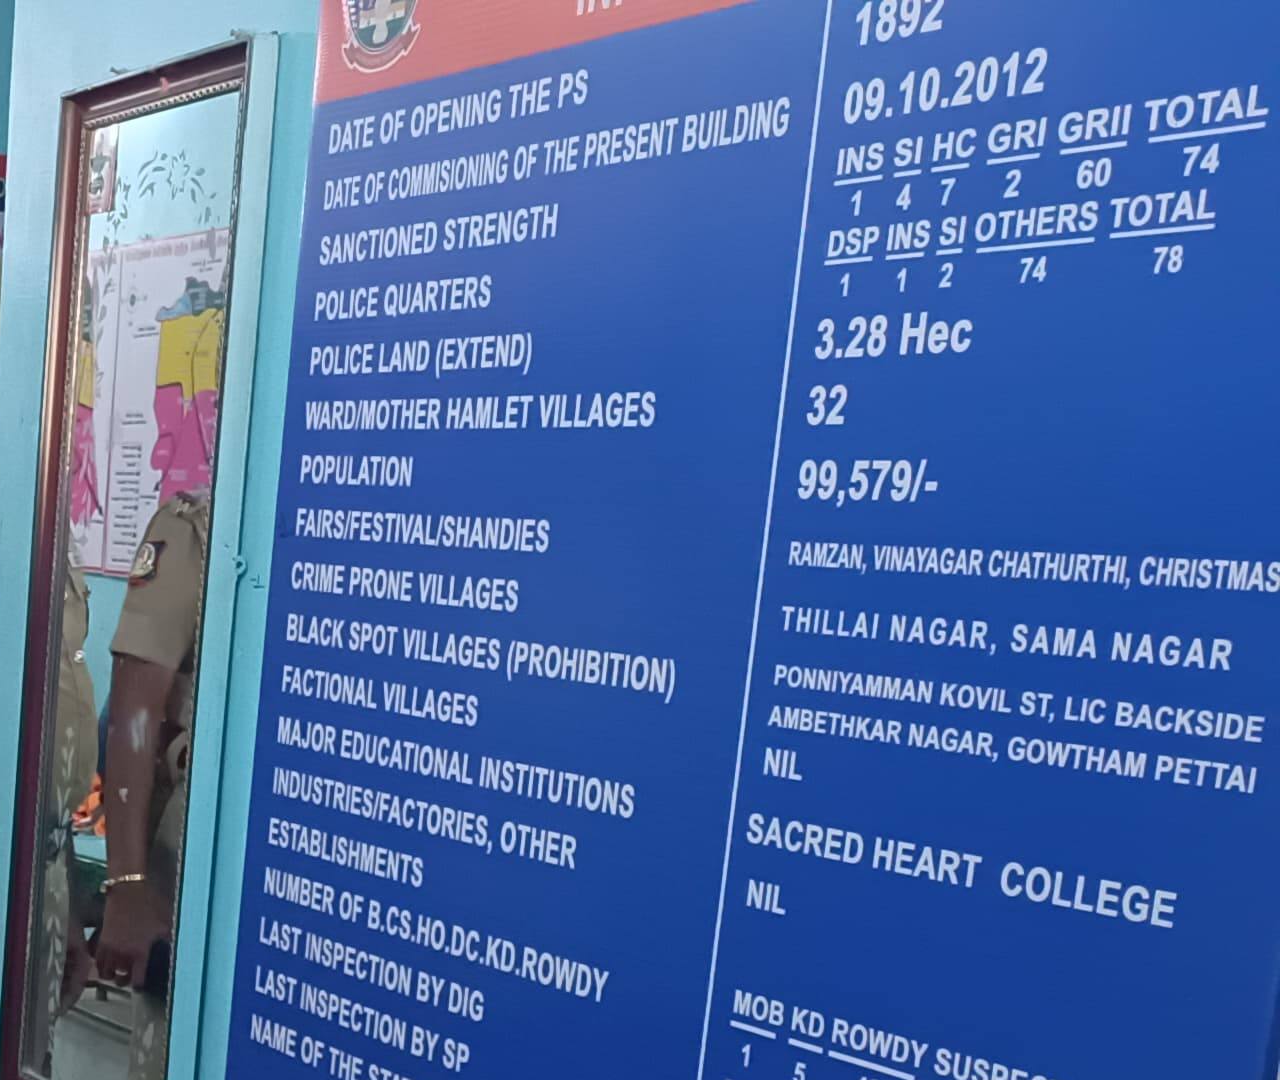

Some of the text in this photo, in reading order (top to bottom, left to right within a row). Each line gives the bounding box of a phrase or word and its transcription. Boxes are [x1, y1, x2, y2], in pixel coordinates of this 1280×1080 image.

[856, 0, 944, 46] 1892
[328, 69, 588, 154] DATE OF OPENING THE PS
[844, 48, 1047, 124] 09.10.2012
[324, 97, 790, 210] DATE OF COMMISIONING OF THE PRESENT BUILDING
[837, 85, 1268, 175] INS SI HC GRI GRII TOTAL
[320, 204, 558, 265] SANCTIONED STRENGTH
[828, 189, 1215, 257] DSP INS SI OTHERS TOTAL
[315, 275, 491, 320] POLICE QUARTERS
[310, 333, 532, 378] POLICE LAND (EXTEND)
[815, 312, 972, 359] 3.28 Hec
[306, 392, 655, 429] WARD/MOTHER HAMLET VILLAGES
[300, 455, 413, 486] POPULATION
[798, 460, 937, 506] 99,579/-
[296, 508, 549, 552] FAIRS/FESTIVAL/SHANDIES
[292, 562, 518, 612] CRIME PRONE VILLAGES
[789, 542, 866, 573] RAMZAN,
[874, 546, 983, 575] VINAYAGAR
[989, 550, 1130, 588] CHATHURTHI,
[287, 614, 674, 703] BLACK SPOT VILLAGES (PROHIBITION)
[782, 606, 1232, 670] THILLAI NAGAR, SAMA NAGAR
[282, 666, 478, 726] FACTIONAL VILLAGES
[774, 665, 1264, 742] PONNIYAMMAN KOVIL ST, LIC BACKSIDE
[278, 717, 634, 818] MAJOR EDUCATIONAL INSTITUTIONS
[764, 748, 801, 780] NIL
[768, 706, 1256, 793] AMBETHKAR NAGAR, GOWTHAM PETTAI
[274, 768, 576, 868] INDUSTRIES/FACTORIES, OTHER
[269, 818, 422, 886] ESTABLISHMENTS
[747, 814, 1176, 928] SACRED HEART COLLEGE
[747, 880, 784, 914] NIL
[264, 868, 608, 1001] NUMBER OF B.CS.HO.DC.KD.ROWDY
[260, 918, 483, 1020] LAST INSPECTION BY DIG
[251, 1015, 296, 1056] NAME
[302, 1037, 324, 1066] OF
[734, 990, 784, 1025] MOB
[792, 1007, 824, 1036] KD
[832, 1019, 928, 1067] ROWDY
